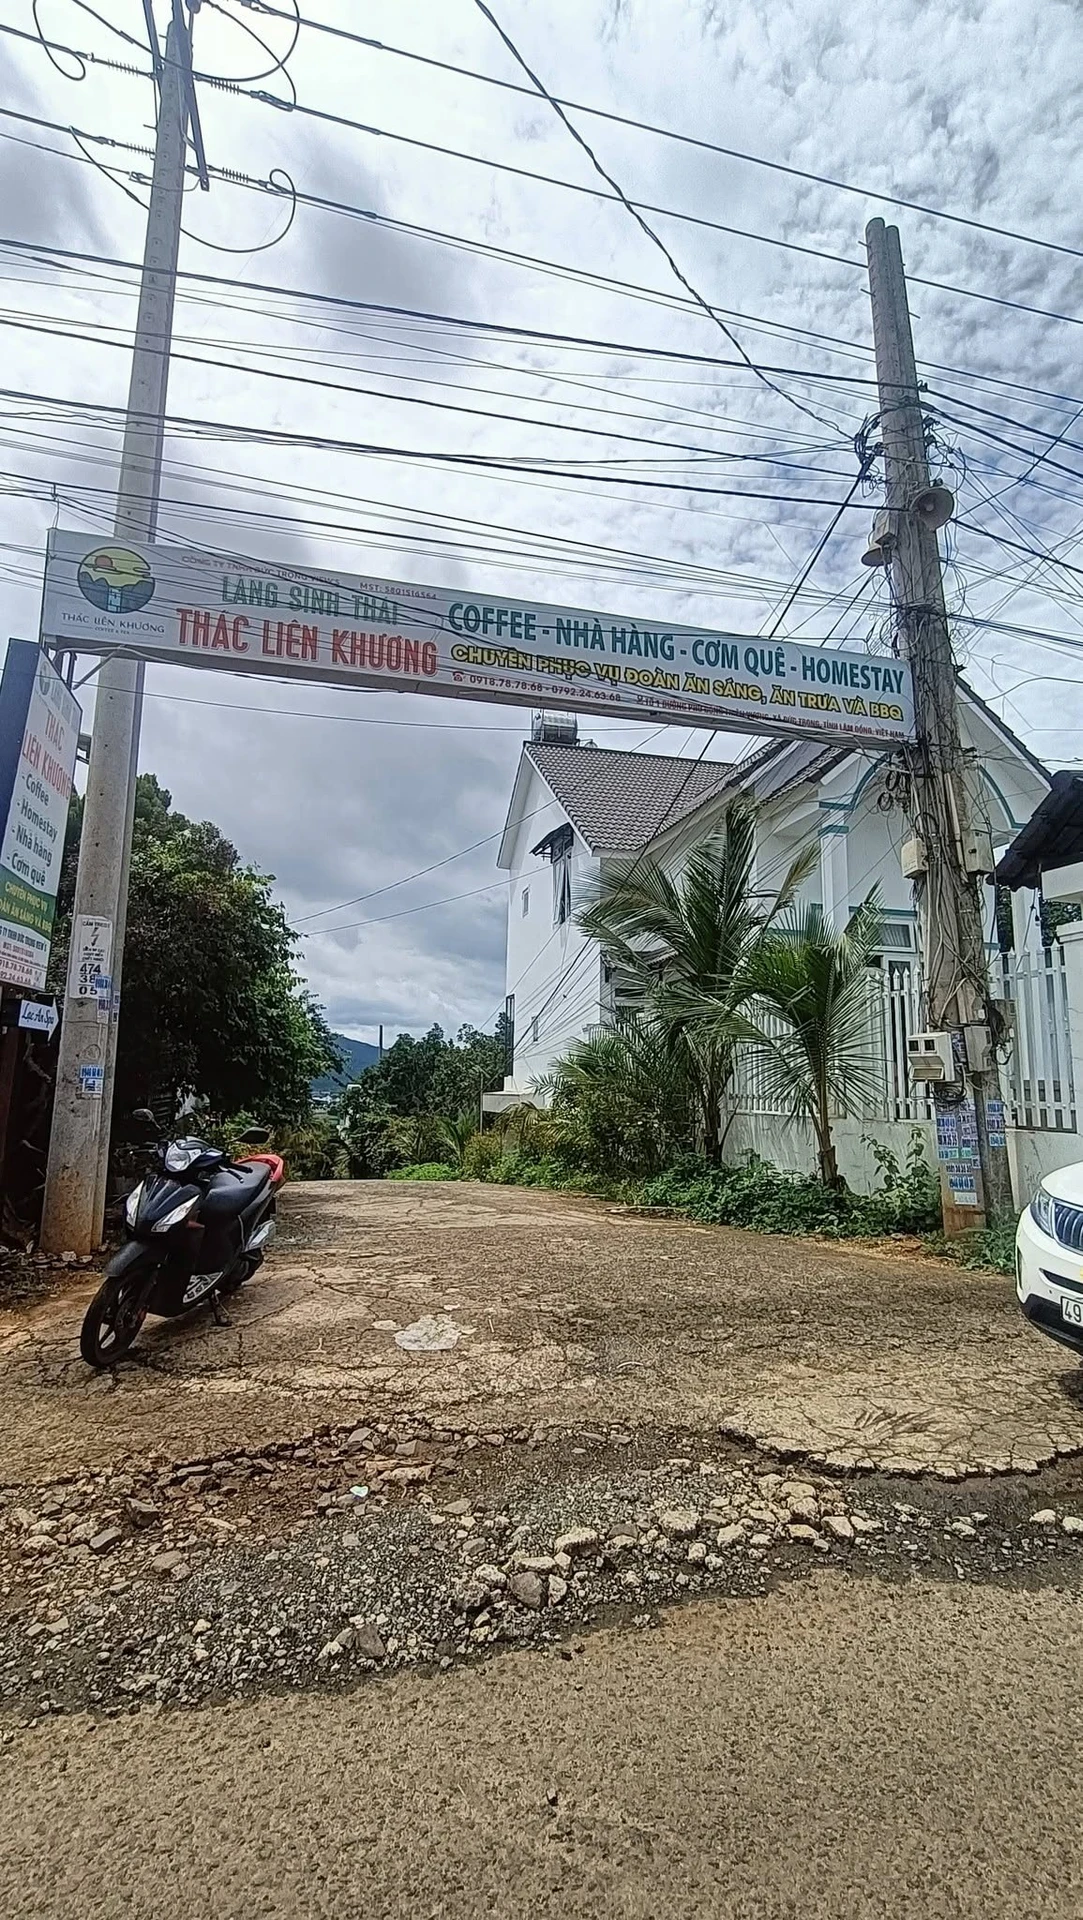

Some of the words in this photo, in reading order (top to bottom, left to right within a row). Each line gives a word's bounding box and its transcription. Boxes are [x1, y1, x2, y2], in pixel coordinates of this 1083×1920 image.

[289, 585, 339, 617] SINH
[61, 612, 90, 624] THÁC
[119, 620, 165, 633] KHƯƠNG
[176, 608, 251, 653] THÁC
[262, 619, 318, 661] LIÊN
[332, 628, 438, 676] KHƯƠNG
[448, 602, 537, 642] COFFEE
[556, 617, 606, 652] NHÀ
[611, 623, 675, 661] HÀNG
[692, 638, 740, 671] CƠM
[744, 646, 787, 678] QUÊ
[802, 655, 905, 695] HOMESTAY
[450, 643, 534, 671] CHUYÊN
[536, 654, 592, 681] PHỤC
[593, 662, 621, 687] VỤ
[624, 666, 680, 691] ĐOÀN
[682, 671, 710, 695] ĂN
[712, 676, 768, 704] SÁNG,
[770, 684, 796, 707] ĂN
[798, 693, 842, 713] TRƯA
[842, 695, 868, 717] VÀ
[870, 701, 904, 721] BBQ
[469, 675, 543, 692] 0918.78.78.68
[25, 773, 50, 807] Coffee
[20, 797, 58, 844] Homestay
[16, 824, 33, 850] Nhà
[32, 836, 53, 868] hàng
[11, 852, 30, 877] Cơm
[30, 869, 46, 887] quê
[79, 963, 101, 975] 474
[80, 974, 95, 984] 38
[79, 986, 98, 995] 05
[1064, 1300, 1083, 1323] 49
